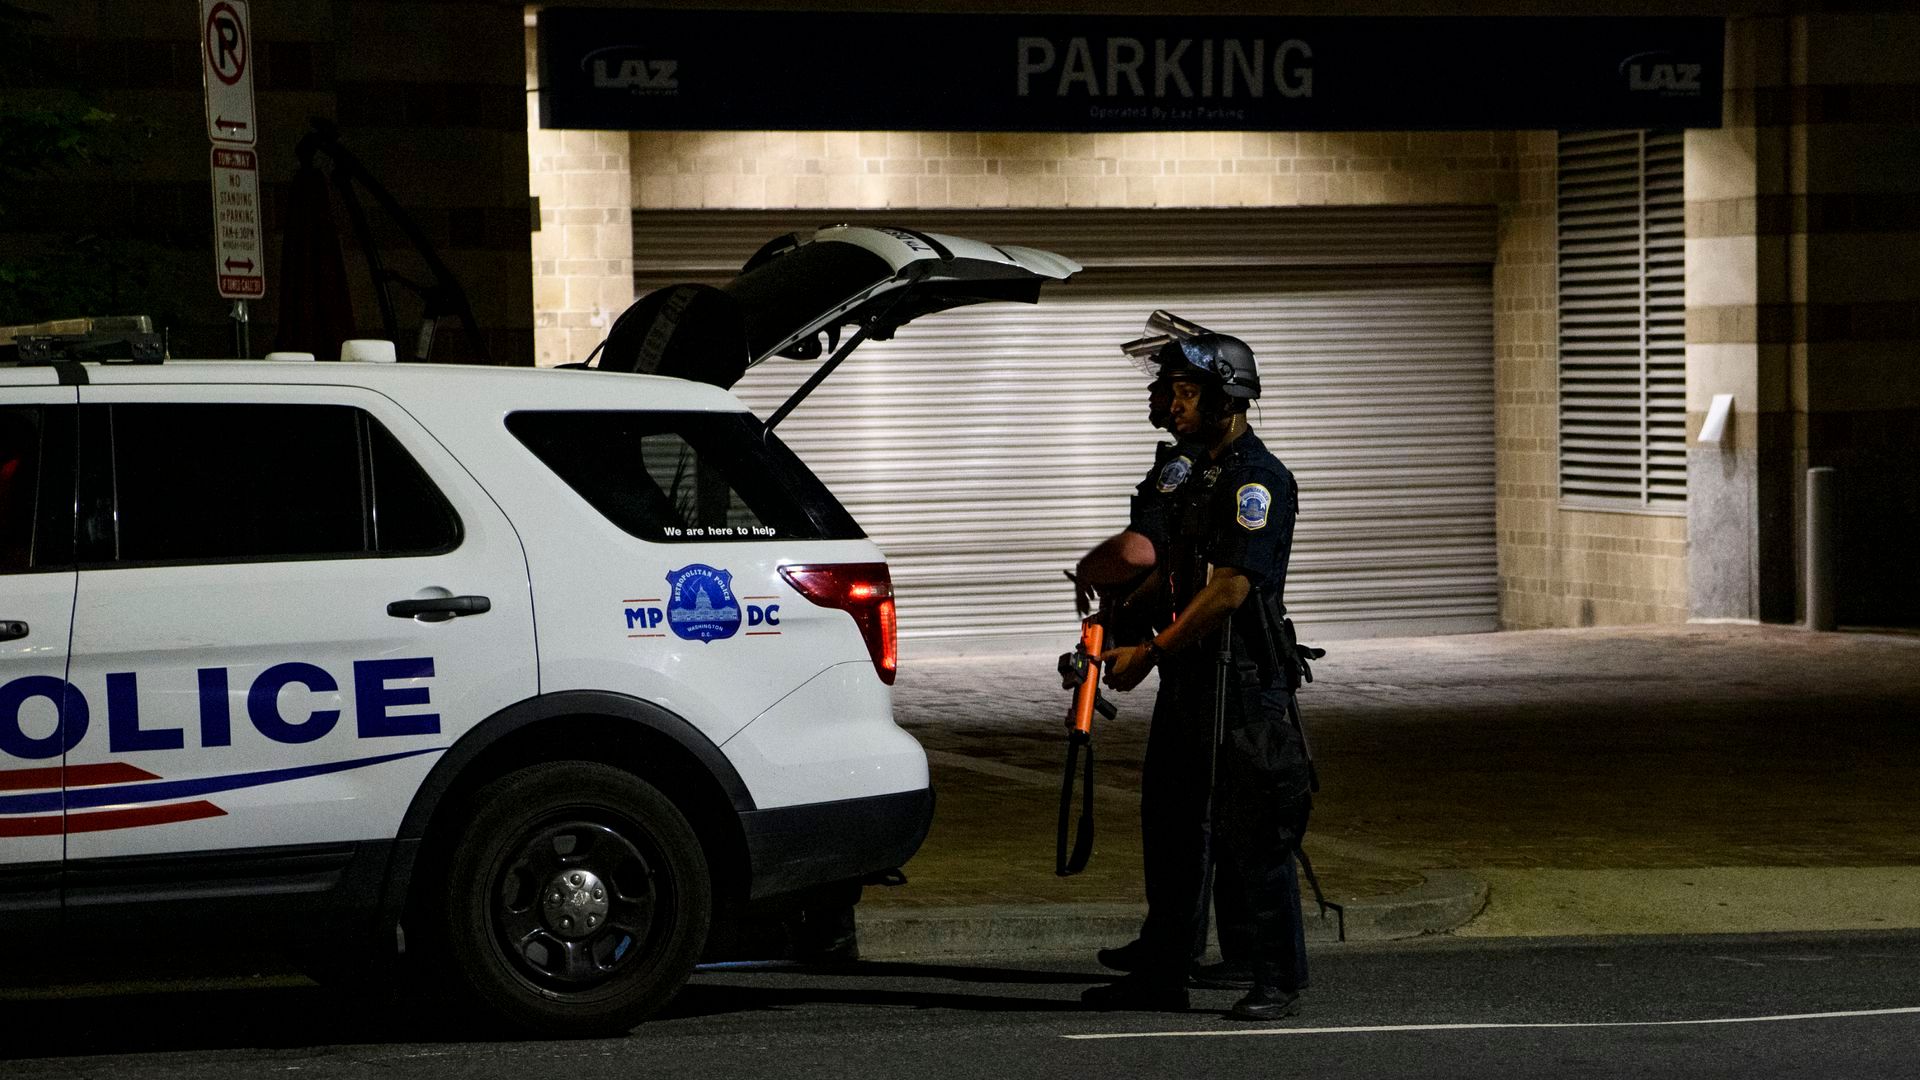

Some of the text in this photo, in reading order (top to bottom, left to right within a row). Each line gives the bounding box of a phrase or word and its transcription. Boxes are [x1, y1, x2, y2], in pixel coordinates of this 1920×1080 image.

[593, 59, 680, 88] LAZ
[1016, 36, 1313, 98] PARKING
[1629, 63, 1702, 91] LAZ
[1089, 105, 1148, 119] Operated
[229, 174, 241, 188] NO
[219, 191, 253, 206] STANDING
[226, 208, 254, 224] PARKING
[664, 525, 776, 537] We are here to help
[674, 569, 731, 602] METROPOLITAN POLICE
[625, 608, 664, 629] MP
[746, 604, 781, 626] DC
[687, 624, 723, 632] WASHINGTON
